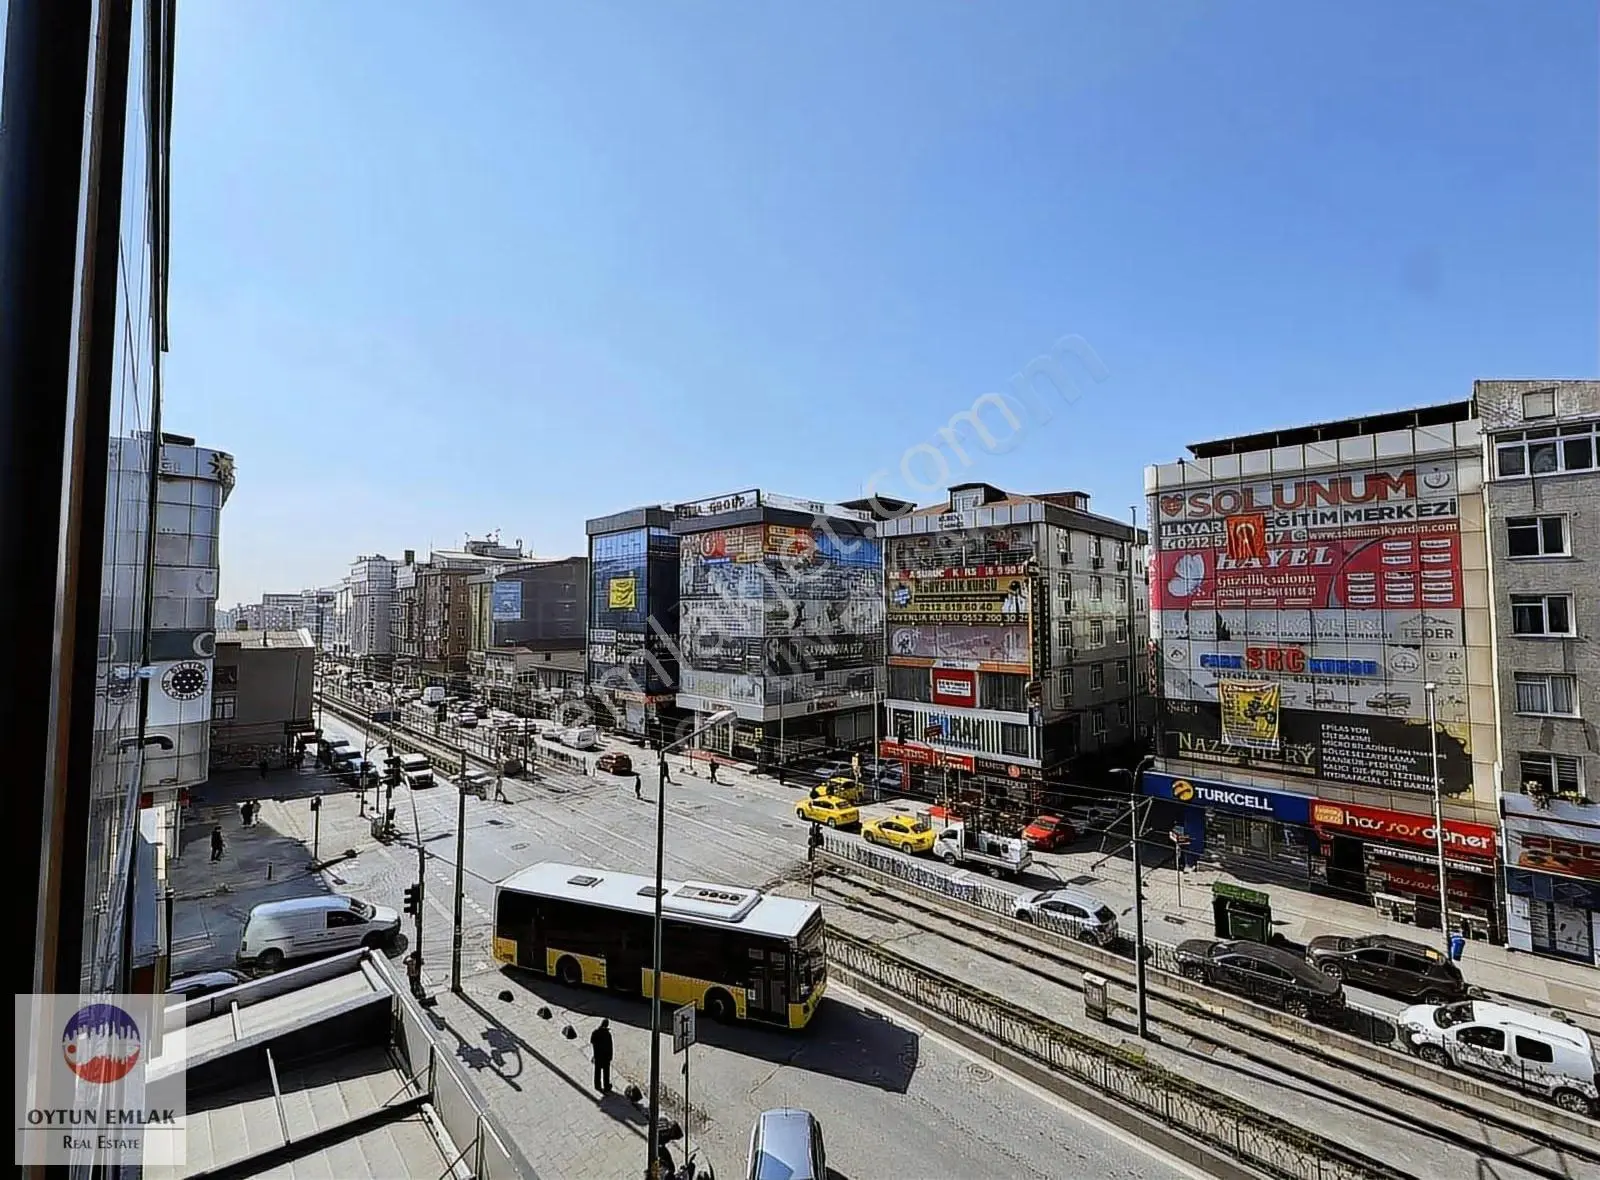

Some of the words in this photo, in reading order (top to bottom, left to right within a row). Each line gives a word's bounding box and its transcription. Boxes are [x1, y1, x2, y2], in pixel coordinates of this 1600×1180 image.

[1187, 469, 1416, 518] SOLUNUM
[1265, 509, 1338, 532] EĞİTİM
[1343, 498, 1457, 523] MERKEZİ
[1177, 537, 1209, 549] 0212
[1264, 531, 1284, 544] 07
[1216, 546, 1332, 570] HAYEL
[1245, 646, 1305, 673] SRC
[1195, 786, 1274, 811] TURKCELL
